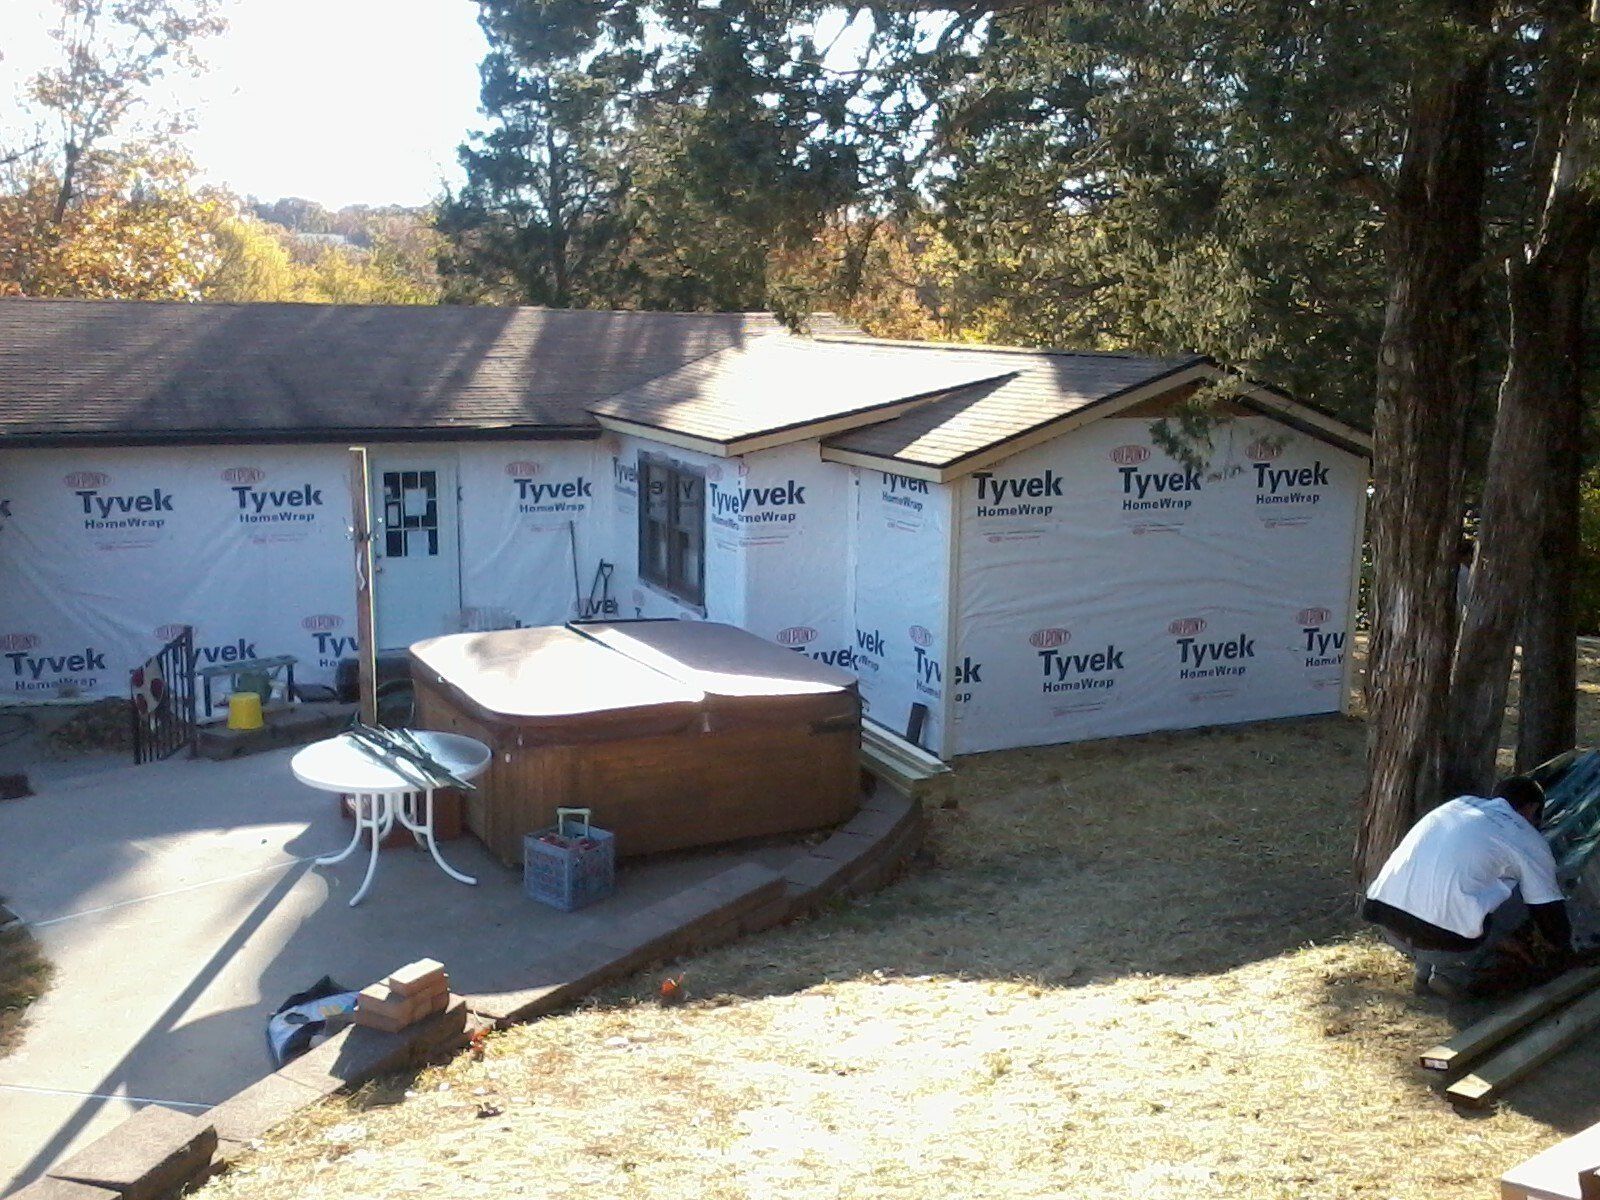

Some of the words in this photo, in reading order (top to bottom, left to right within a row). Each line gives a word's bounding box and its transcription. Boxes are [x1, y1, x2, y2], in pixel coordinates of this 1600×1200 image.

[514, 477, 592, 504] Tyvek
[972, 470, 1064, 505] Tyvek
[1118, 465, 1202, 499] Tyvek
[1253, 461, 1330, 493] Tyvek
[75, 488, 174, 518] Tyvek
[232, 484, 323, 513] Tyvek
[520, 502, 585, 513] HomeWrap
[977, 504, 1053, 517] HomeWrap
[1122, 498, 1192, 511] HomeWrap
[1256, 493, 1320, 504] HomeWrap
[85, 519, 165, 530] HomeWrap
[240, 512, 315, 523] HomeWrap
[5, 648, 105, 680] Tyvek
[1039, 645, 1124, 681] Tyvek
[1176, 633, 1255, 668] Tyvek
[1043, 678, 1114, 692] HomeWrap
[1180, 666, 1246, 679] HomeWrap
